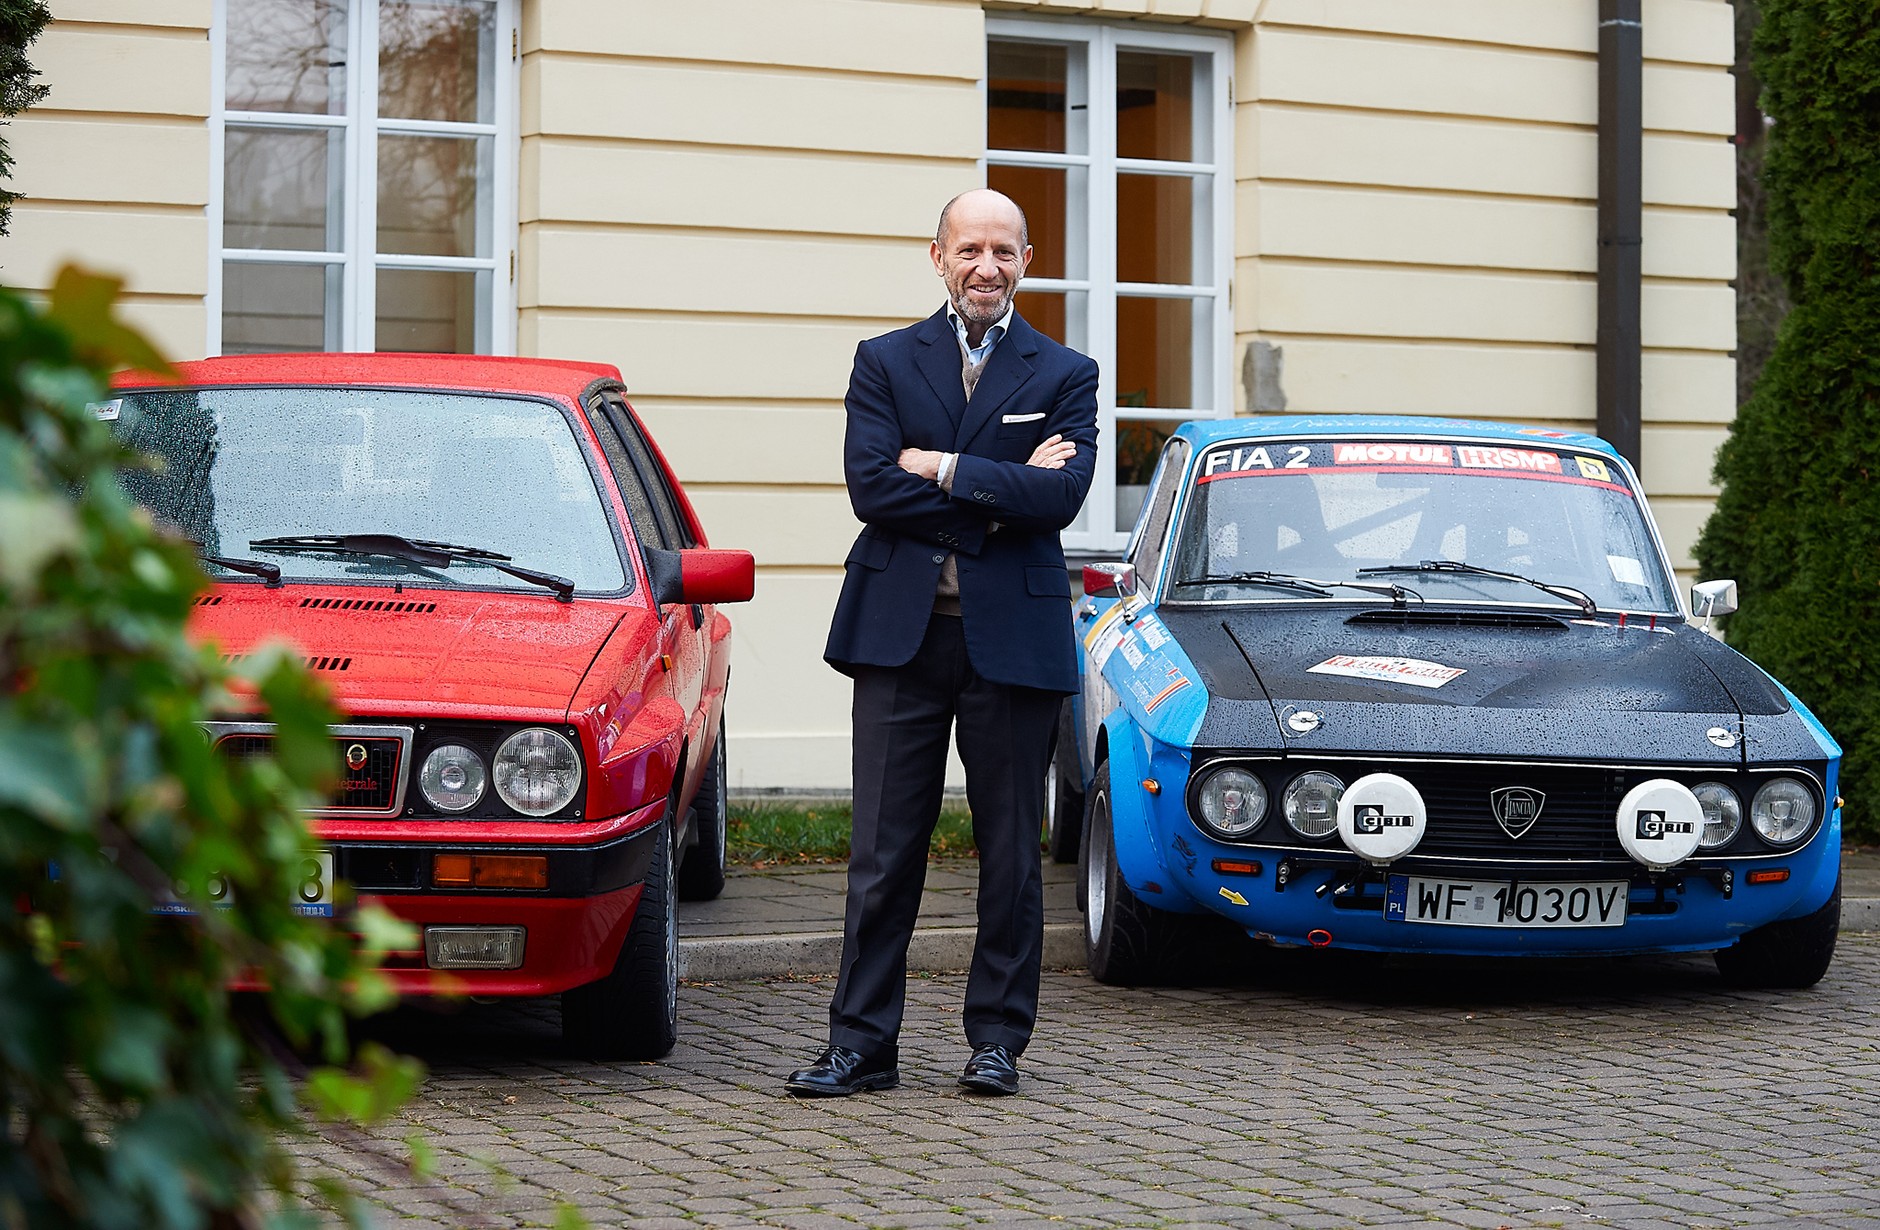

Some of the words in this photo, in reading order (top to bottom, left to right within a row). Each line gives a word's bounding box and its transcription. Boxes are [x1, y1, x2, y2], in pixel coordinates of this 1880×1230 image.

[1205, 447, 1274, 476] FIA
[1285, 446, 1311, 468] 2
[1338, 445, 1449, 463] MOTUL
[1509, 800, 1531, 816] LANCIA
[1390, 903, 1403, 913] PL
[1418, 882, 1473, 920] WF
[1493, 886, 1618, 923] 1030V
